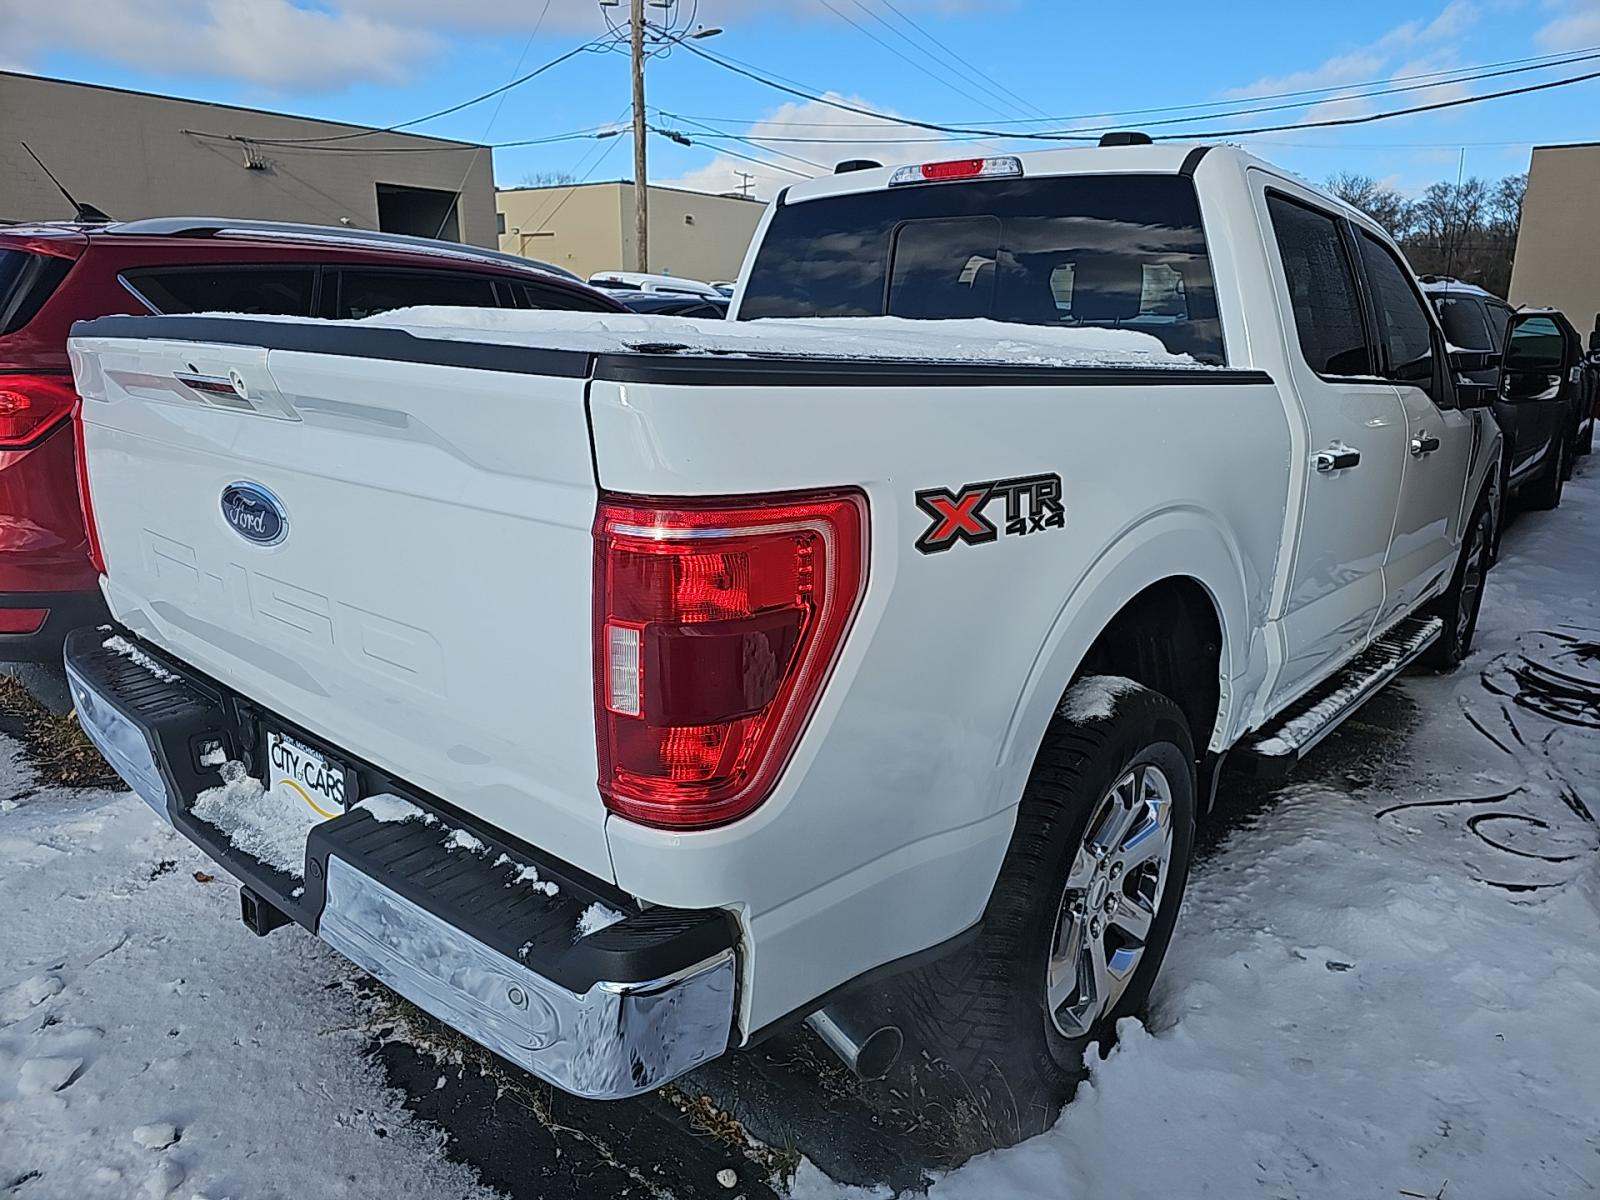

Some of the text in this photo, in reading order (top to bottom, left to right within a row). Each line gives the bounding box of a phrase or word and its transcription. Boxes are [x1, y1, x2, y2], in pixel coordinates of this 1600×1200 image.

[229, 494, 266, 533] Ford
[137, 527, 449, 698] F-150
[271, 742, 300, 779] CITY
[304, 761, 345, 805] CARS
